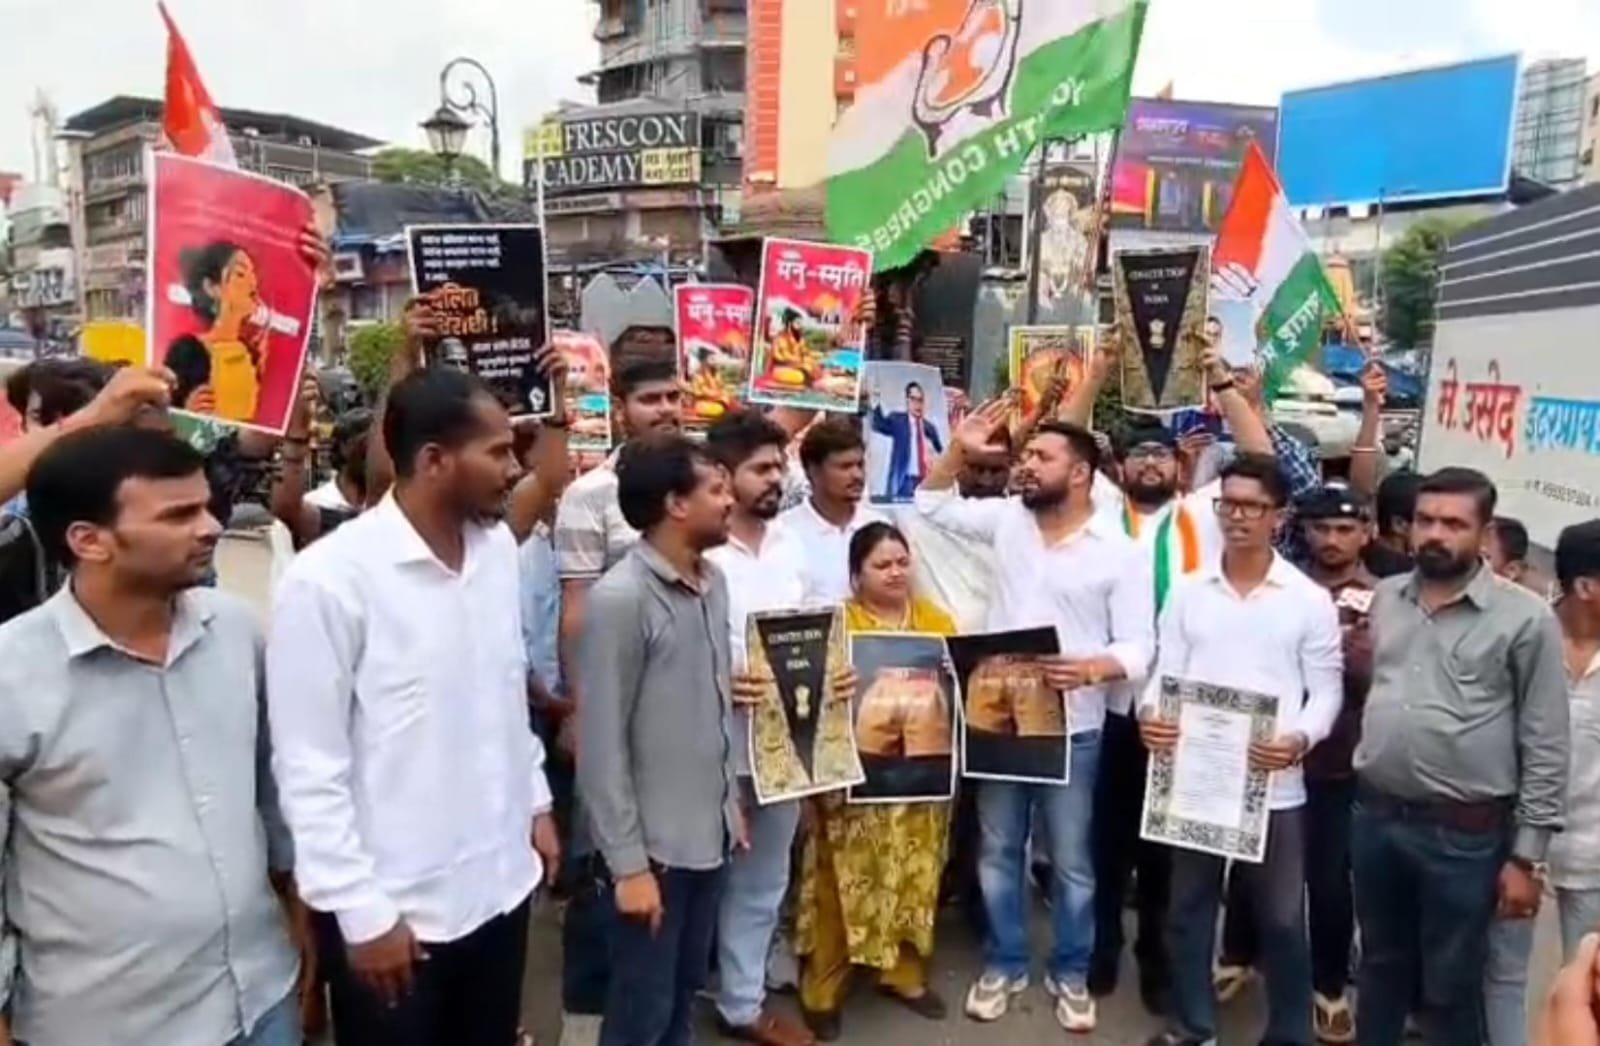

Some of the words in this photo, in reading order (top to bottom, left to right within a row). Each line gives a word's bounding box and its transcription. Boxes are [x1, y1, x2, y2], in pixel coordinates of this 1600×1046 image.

[565, 115, 687, 151] FRESCON
[528, 153, 641, 188] ACADEMY
[1437, 358, 1458, 430] मे.
